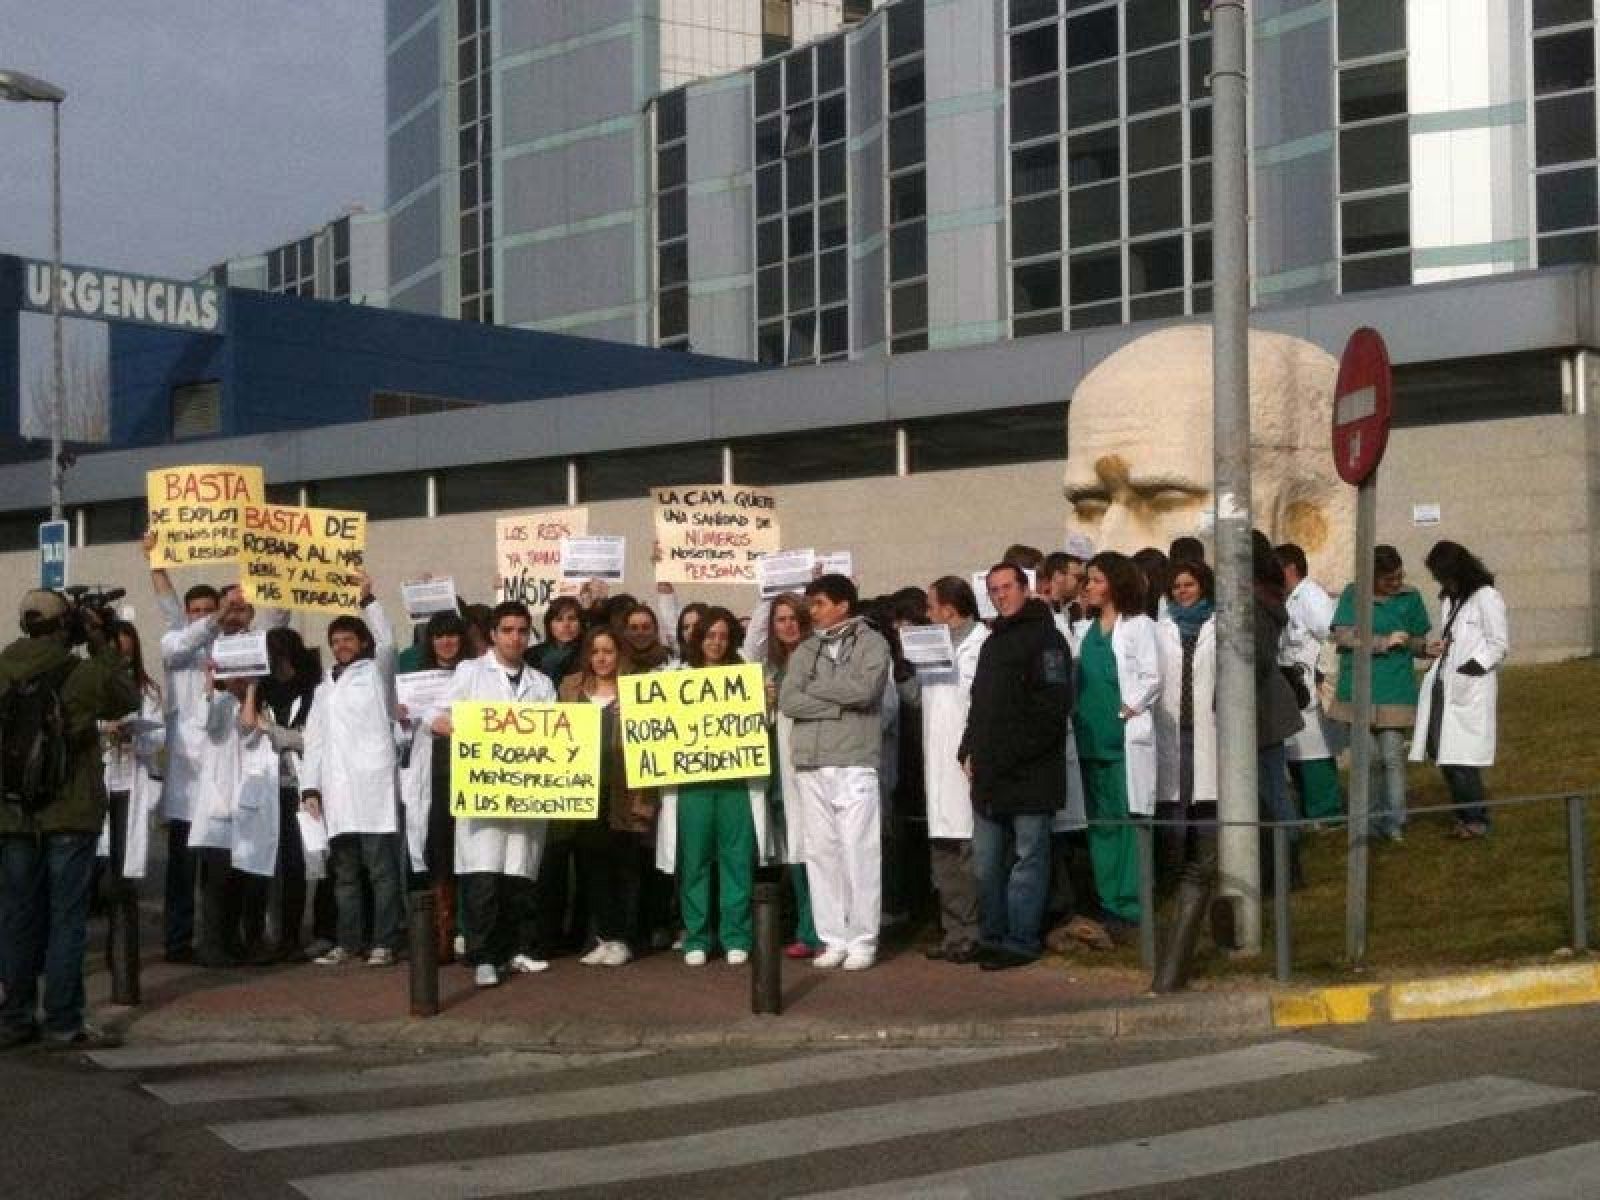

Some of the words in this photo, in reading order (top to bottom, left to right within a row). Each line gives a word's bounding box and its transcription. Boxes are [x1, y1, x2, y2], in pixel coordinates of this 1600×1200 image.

[28, 263, 219, 330] URGENCIAS
[164, 472, 250, 502] BASTA
[658, 491, 678, 505] LA
[245, 507, 312, 536] BASTA
[325, 515, 360, 540] DE
[243, 533, 303, 562] ROBAR
[307, 544, 331, 564] AL
[301, 569, 321, 583] AL
[635, 679, 667, 705] LA
[482, 707, 574, 742] BASTA
[625, 716, 679, 744] ROBA
[703, 712, 769, 738] EXPLOTA
[459, 742, 482, 759] DE
[491, 742, 556, 764] ROBAR
[639, 749, 667, 779] AL
[673, 745, 766, 775] RESIDENTE
[455, 790, 467, 811] A
[474, 793, 499, 811] LOS
